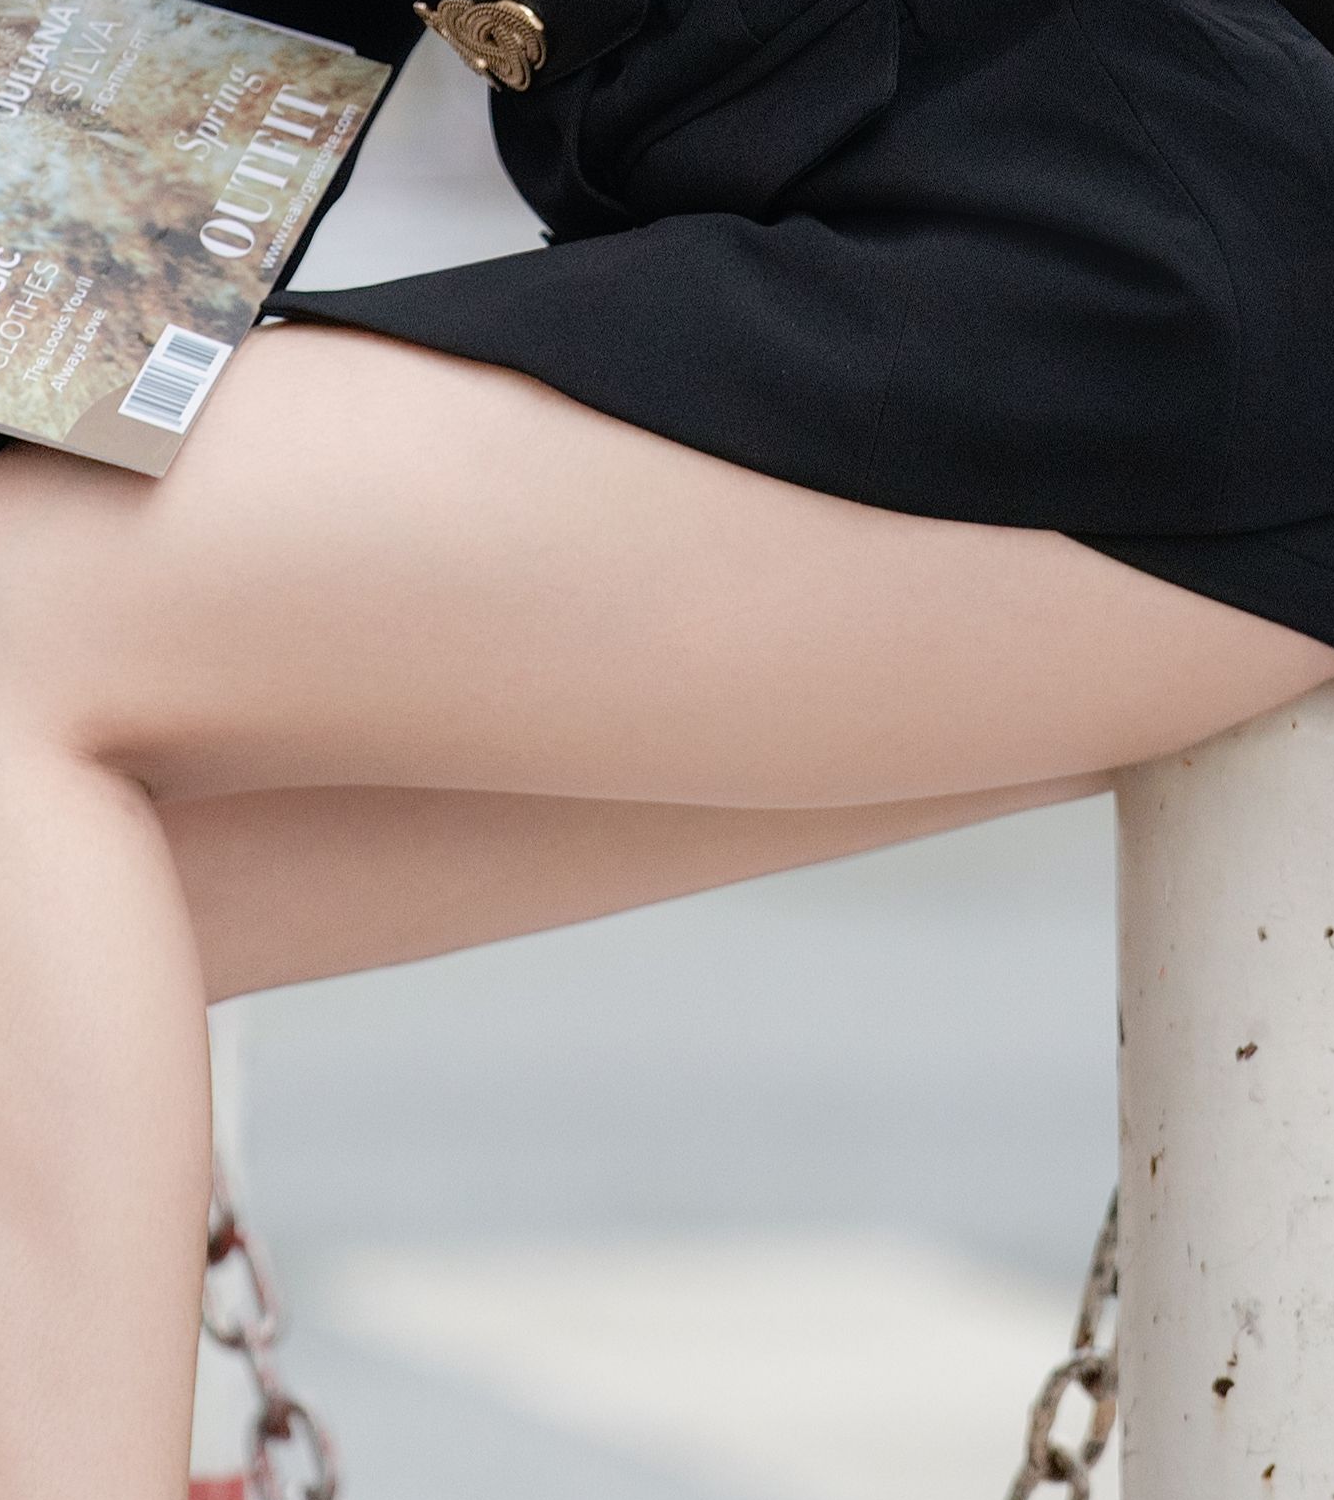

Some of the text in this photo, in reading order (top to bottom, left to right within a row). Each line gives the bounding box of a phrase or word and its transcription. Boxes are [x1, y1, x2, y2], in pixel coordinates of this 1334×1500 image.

[51, 21, 123, 100] SILVA
[174, 64, 265, 162] Spring
[199, 84, 328, 258] OUTFIT
[261, 104, 359, 269] www.reallygreatsite.com
[23, 276, 94, 382] The Looks You'll
[51, 343, 86, 393] Always
